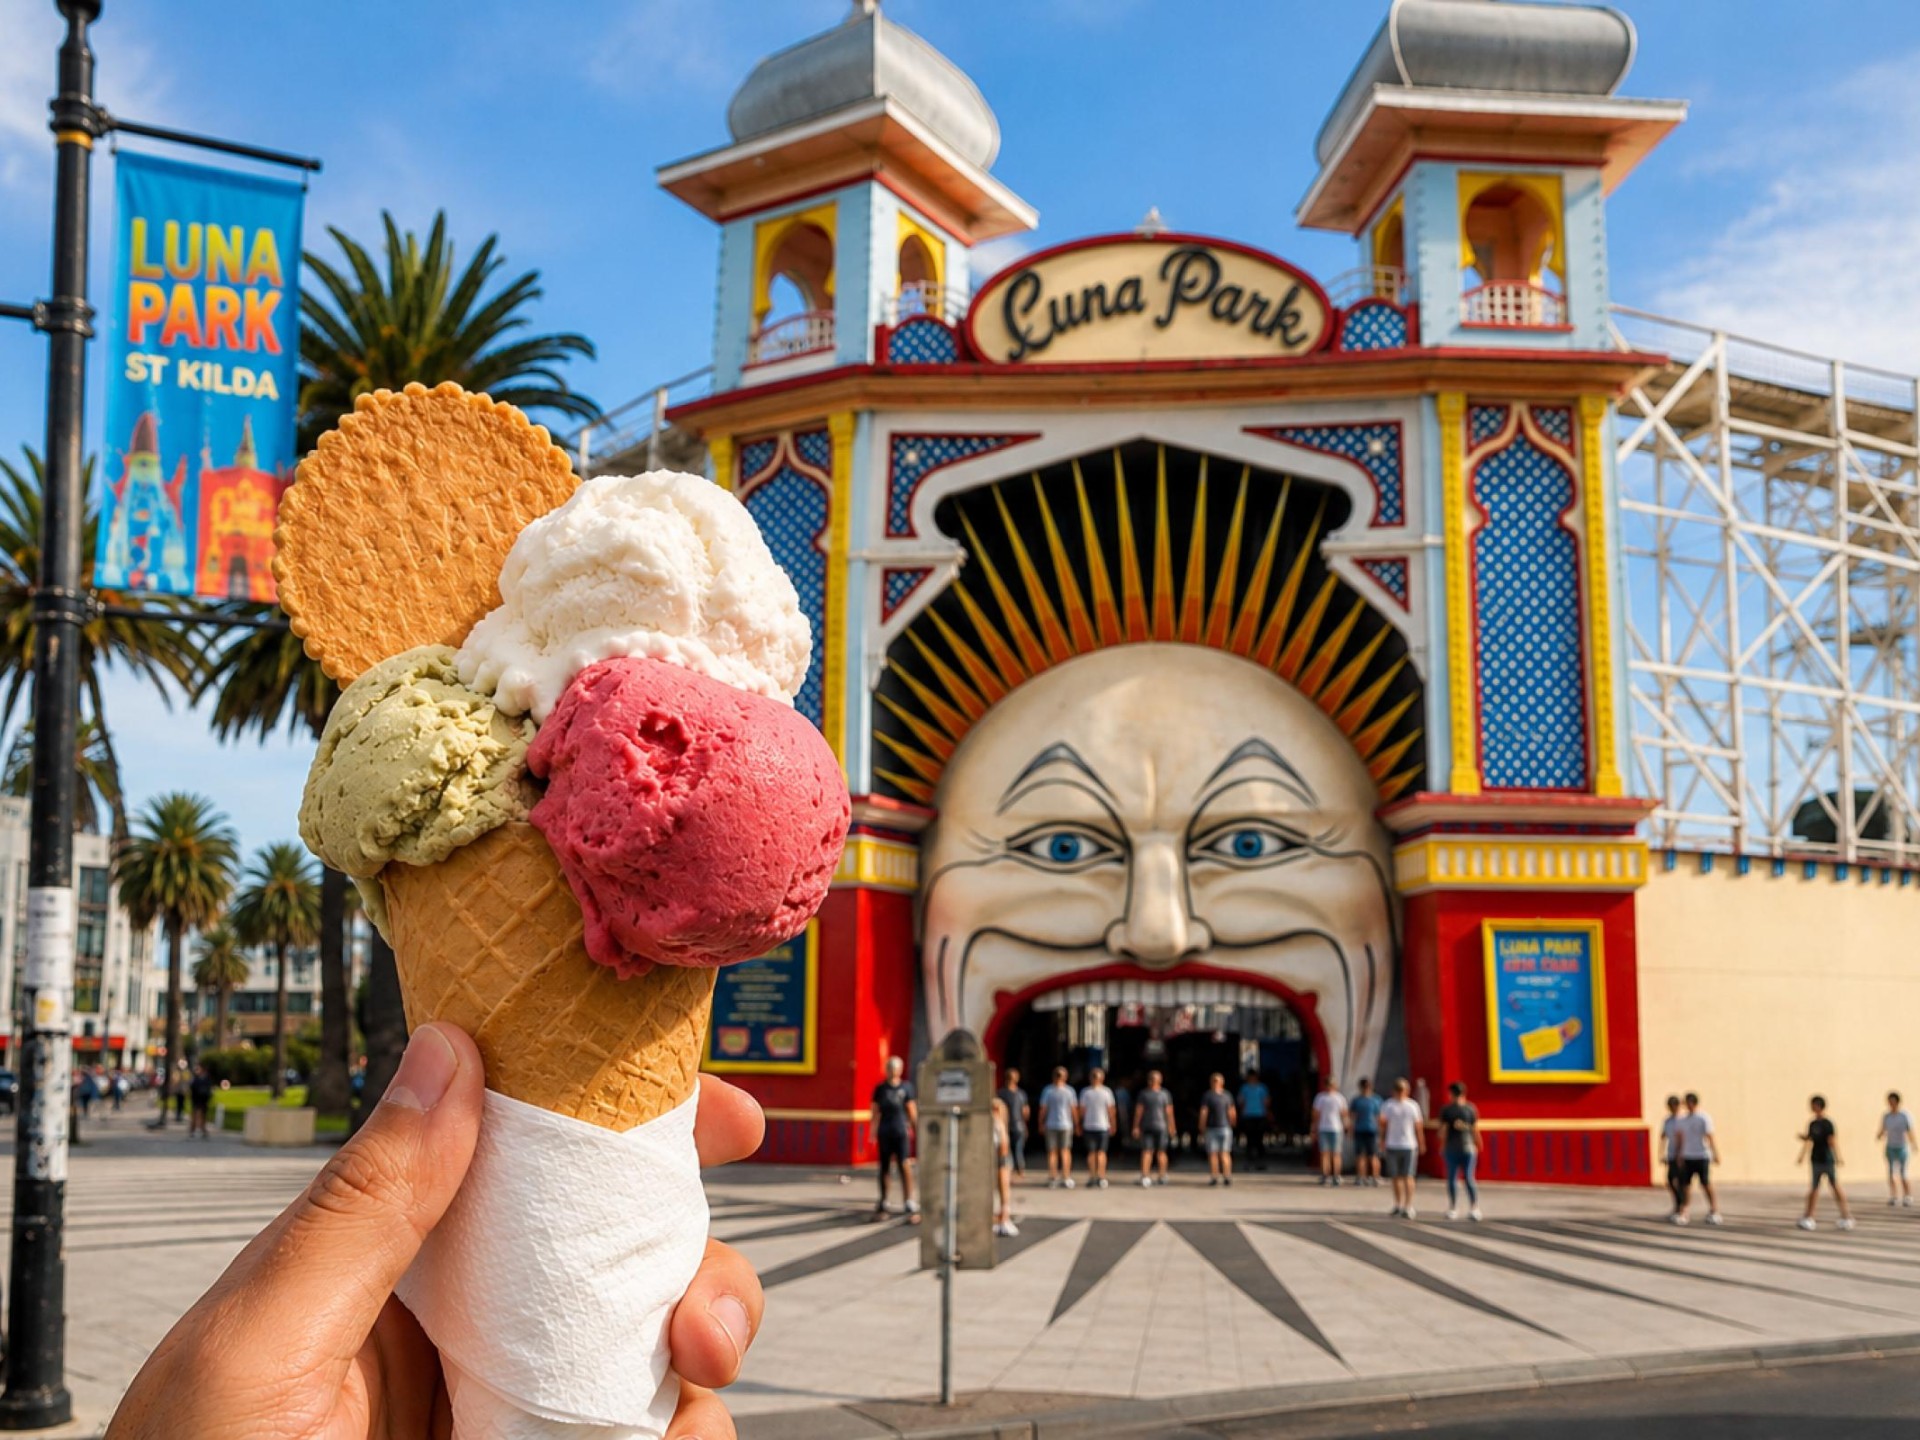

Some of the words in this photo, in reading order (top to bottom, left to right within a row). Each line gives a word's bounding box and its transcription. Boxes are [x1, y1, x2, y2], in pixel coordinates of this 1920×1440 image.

[131, 217, 284, 286] LUNA
[128, 281, 282, 354] PARK
[1003, 269, 1146, 362] Luna
[1155, 245, 1307, 348] Park
[125, 352, 169, 384] ST
[177, 360, 279, 400] KILDA
